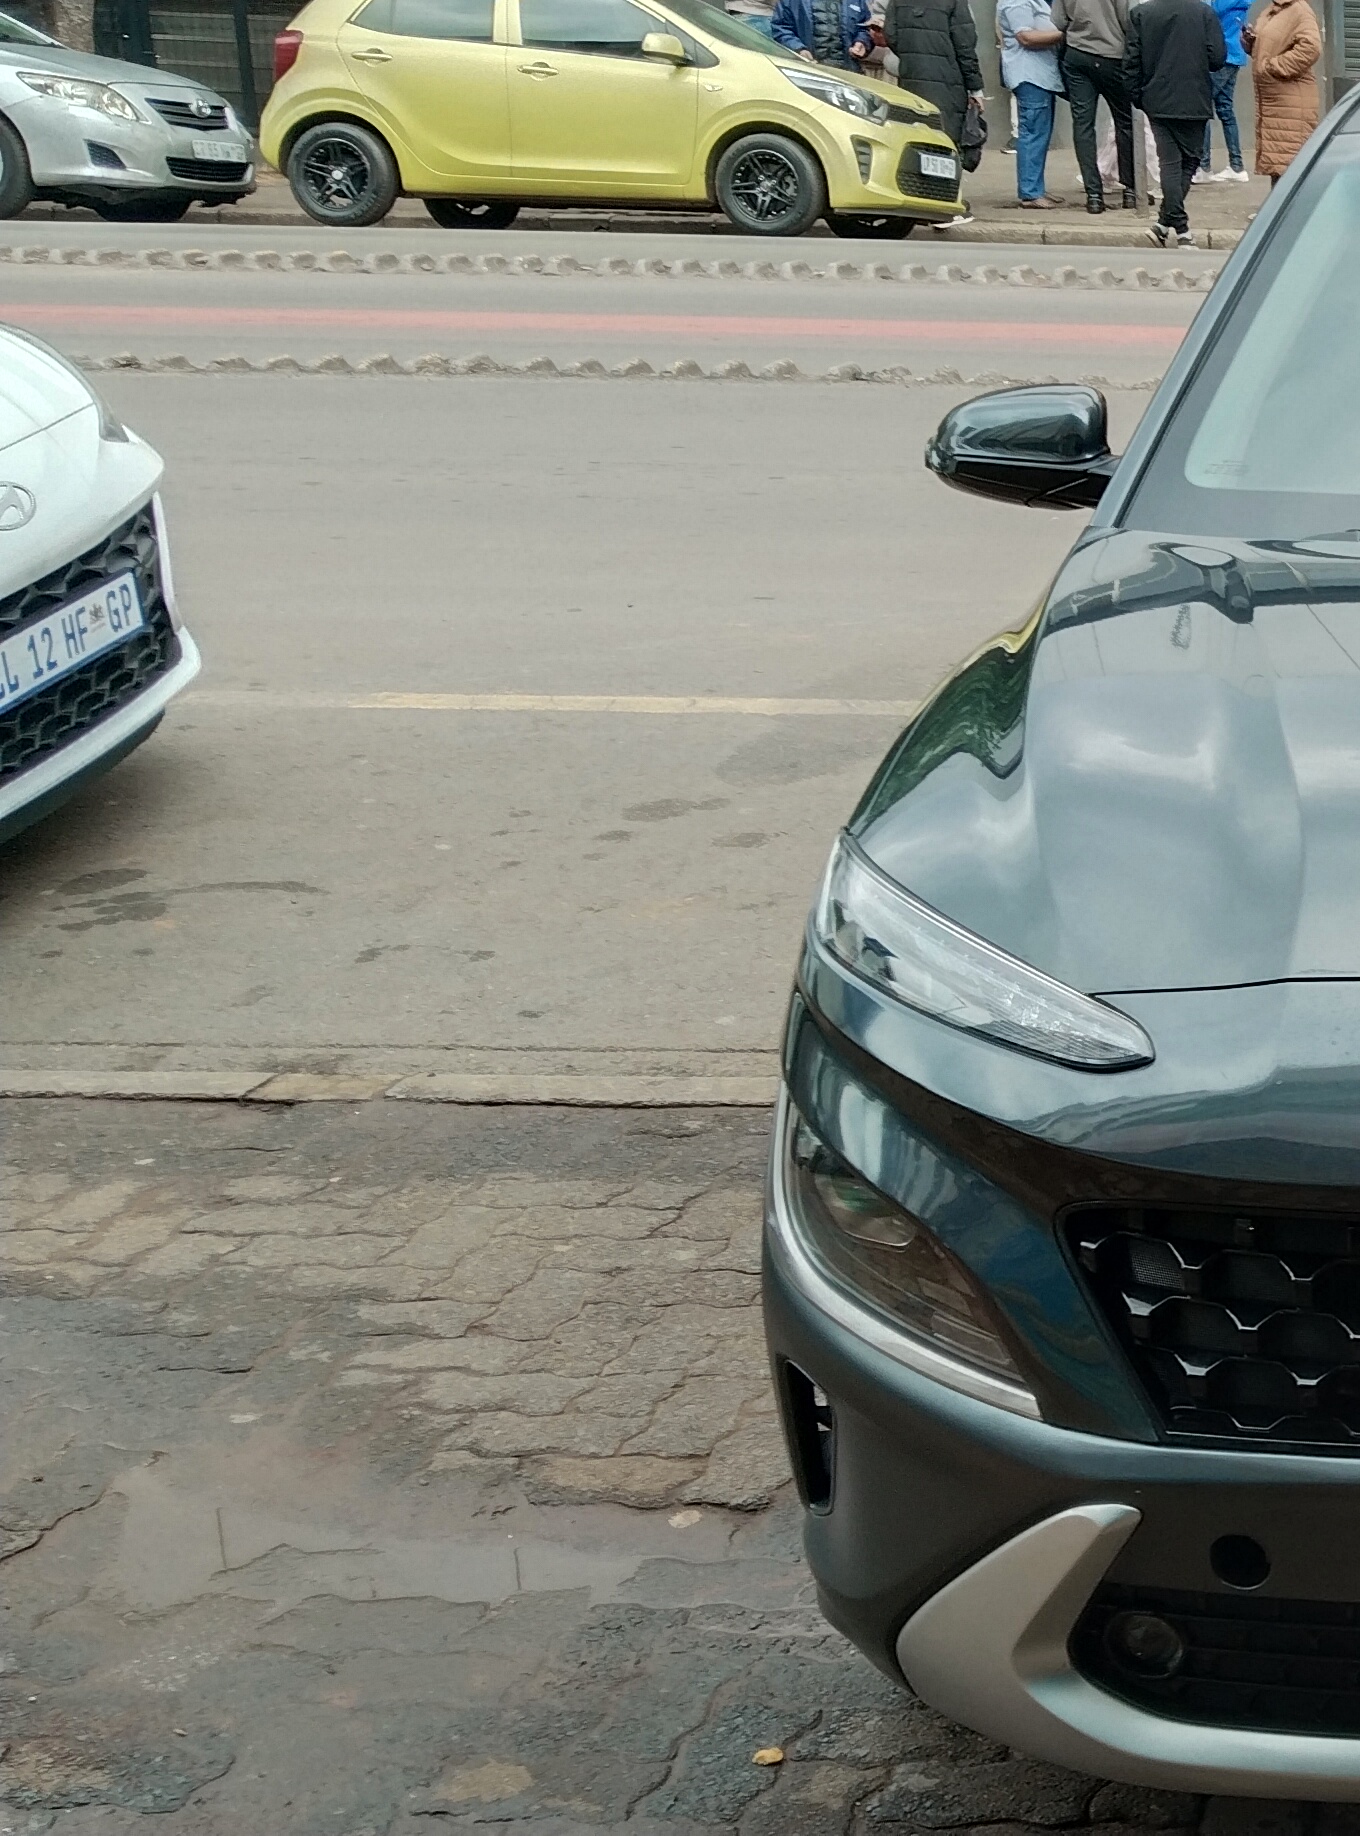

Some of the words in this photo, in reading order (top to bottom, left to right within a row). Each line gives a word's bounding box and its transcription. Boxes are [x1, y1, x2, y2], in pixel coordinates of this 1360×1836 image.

[27, 627, 58, 679] 12
[61, 606, 88, 659] HF
[106, 584, 132, 632] GP
